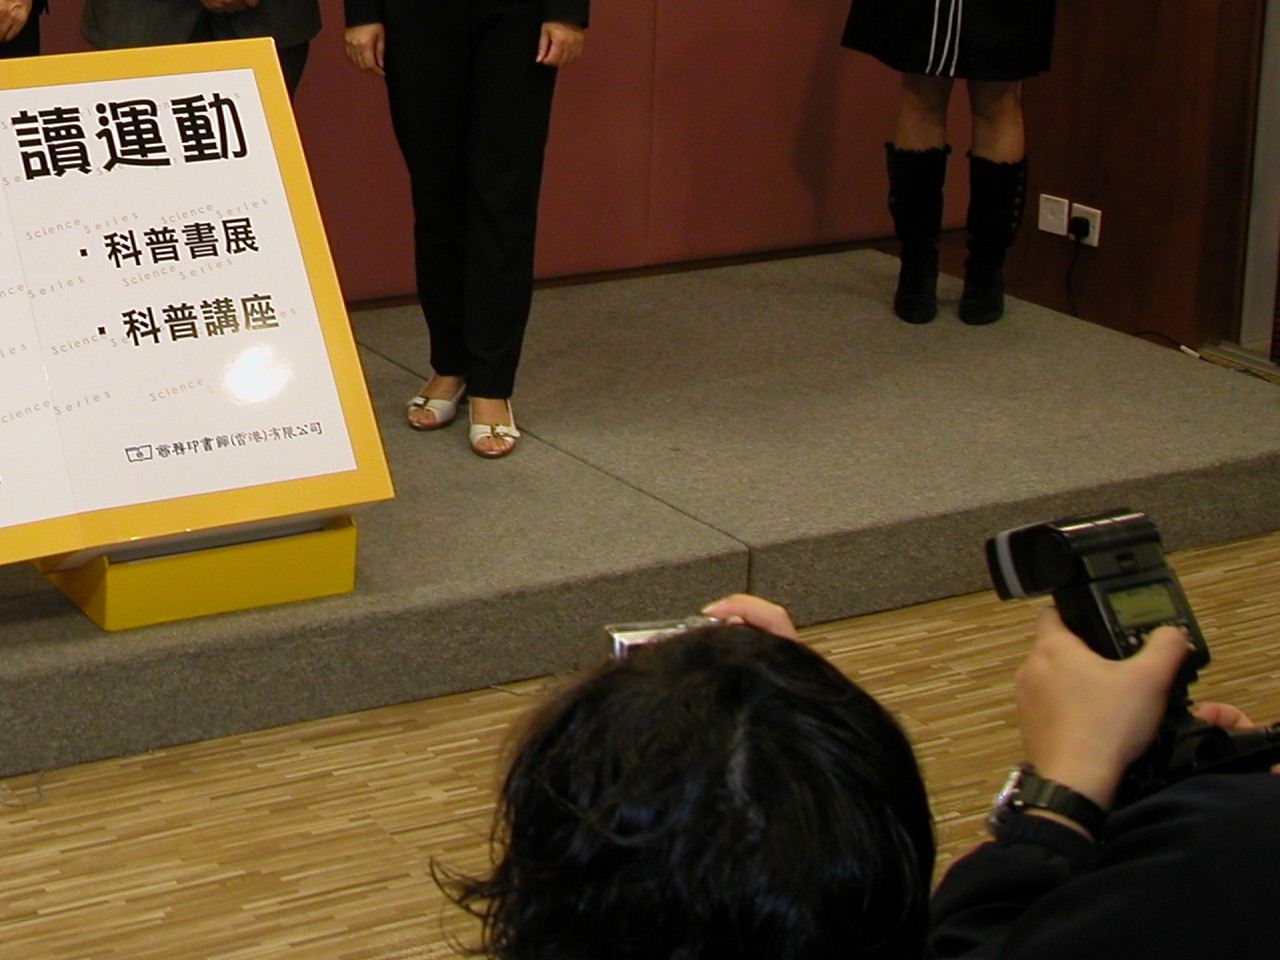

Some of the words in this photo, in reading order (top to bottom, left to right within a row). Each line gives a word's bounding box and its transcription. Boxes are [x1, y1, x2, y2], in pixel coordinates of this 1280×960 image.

[102, 216, 260, 269] 科普書展
[121, 292, 280, 347] 科普講座
